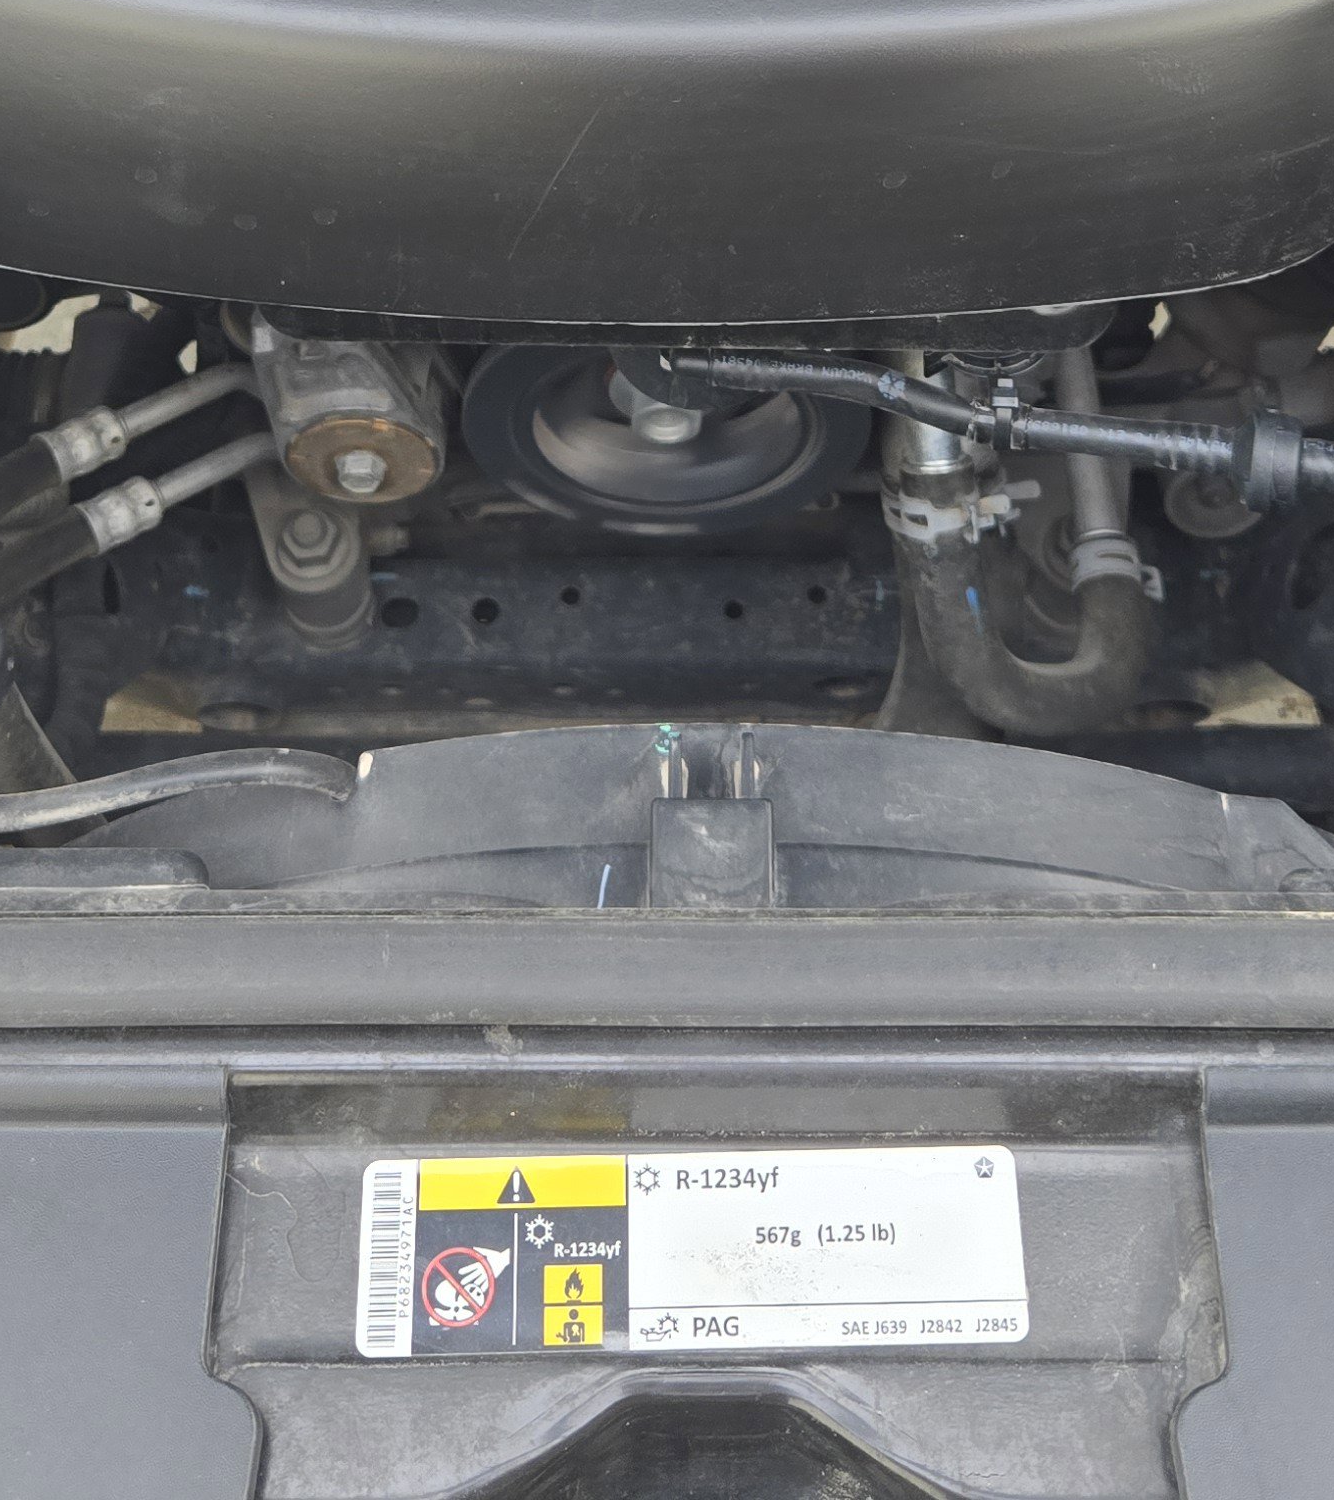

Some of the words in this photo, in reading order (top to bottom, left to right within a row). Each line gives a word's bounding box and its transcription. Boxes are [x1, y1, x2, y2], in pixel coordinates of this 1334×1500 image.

[675, 1165, 780, 1193] R-1234yf
[755, 1226, 802, 1248] 567g
[816, 1224, 866, 1248] (1.25
[871, 1221, 896, 1246] lb)
[553, 1240, 622, 1260] R-1234yf
[692, 1315, 740, 1338] PAG
[841, 1321, 870, 1336] SAE
[873, 1320, 908, 1335] J639
[919, 1319, 963, 1334] J2842
[974, 1317, 1018, 1333] J2845
